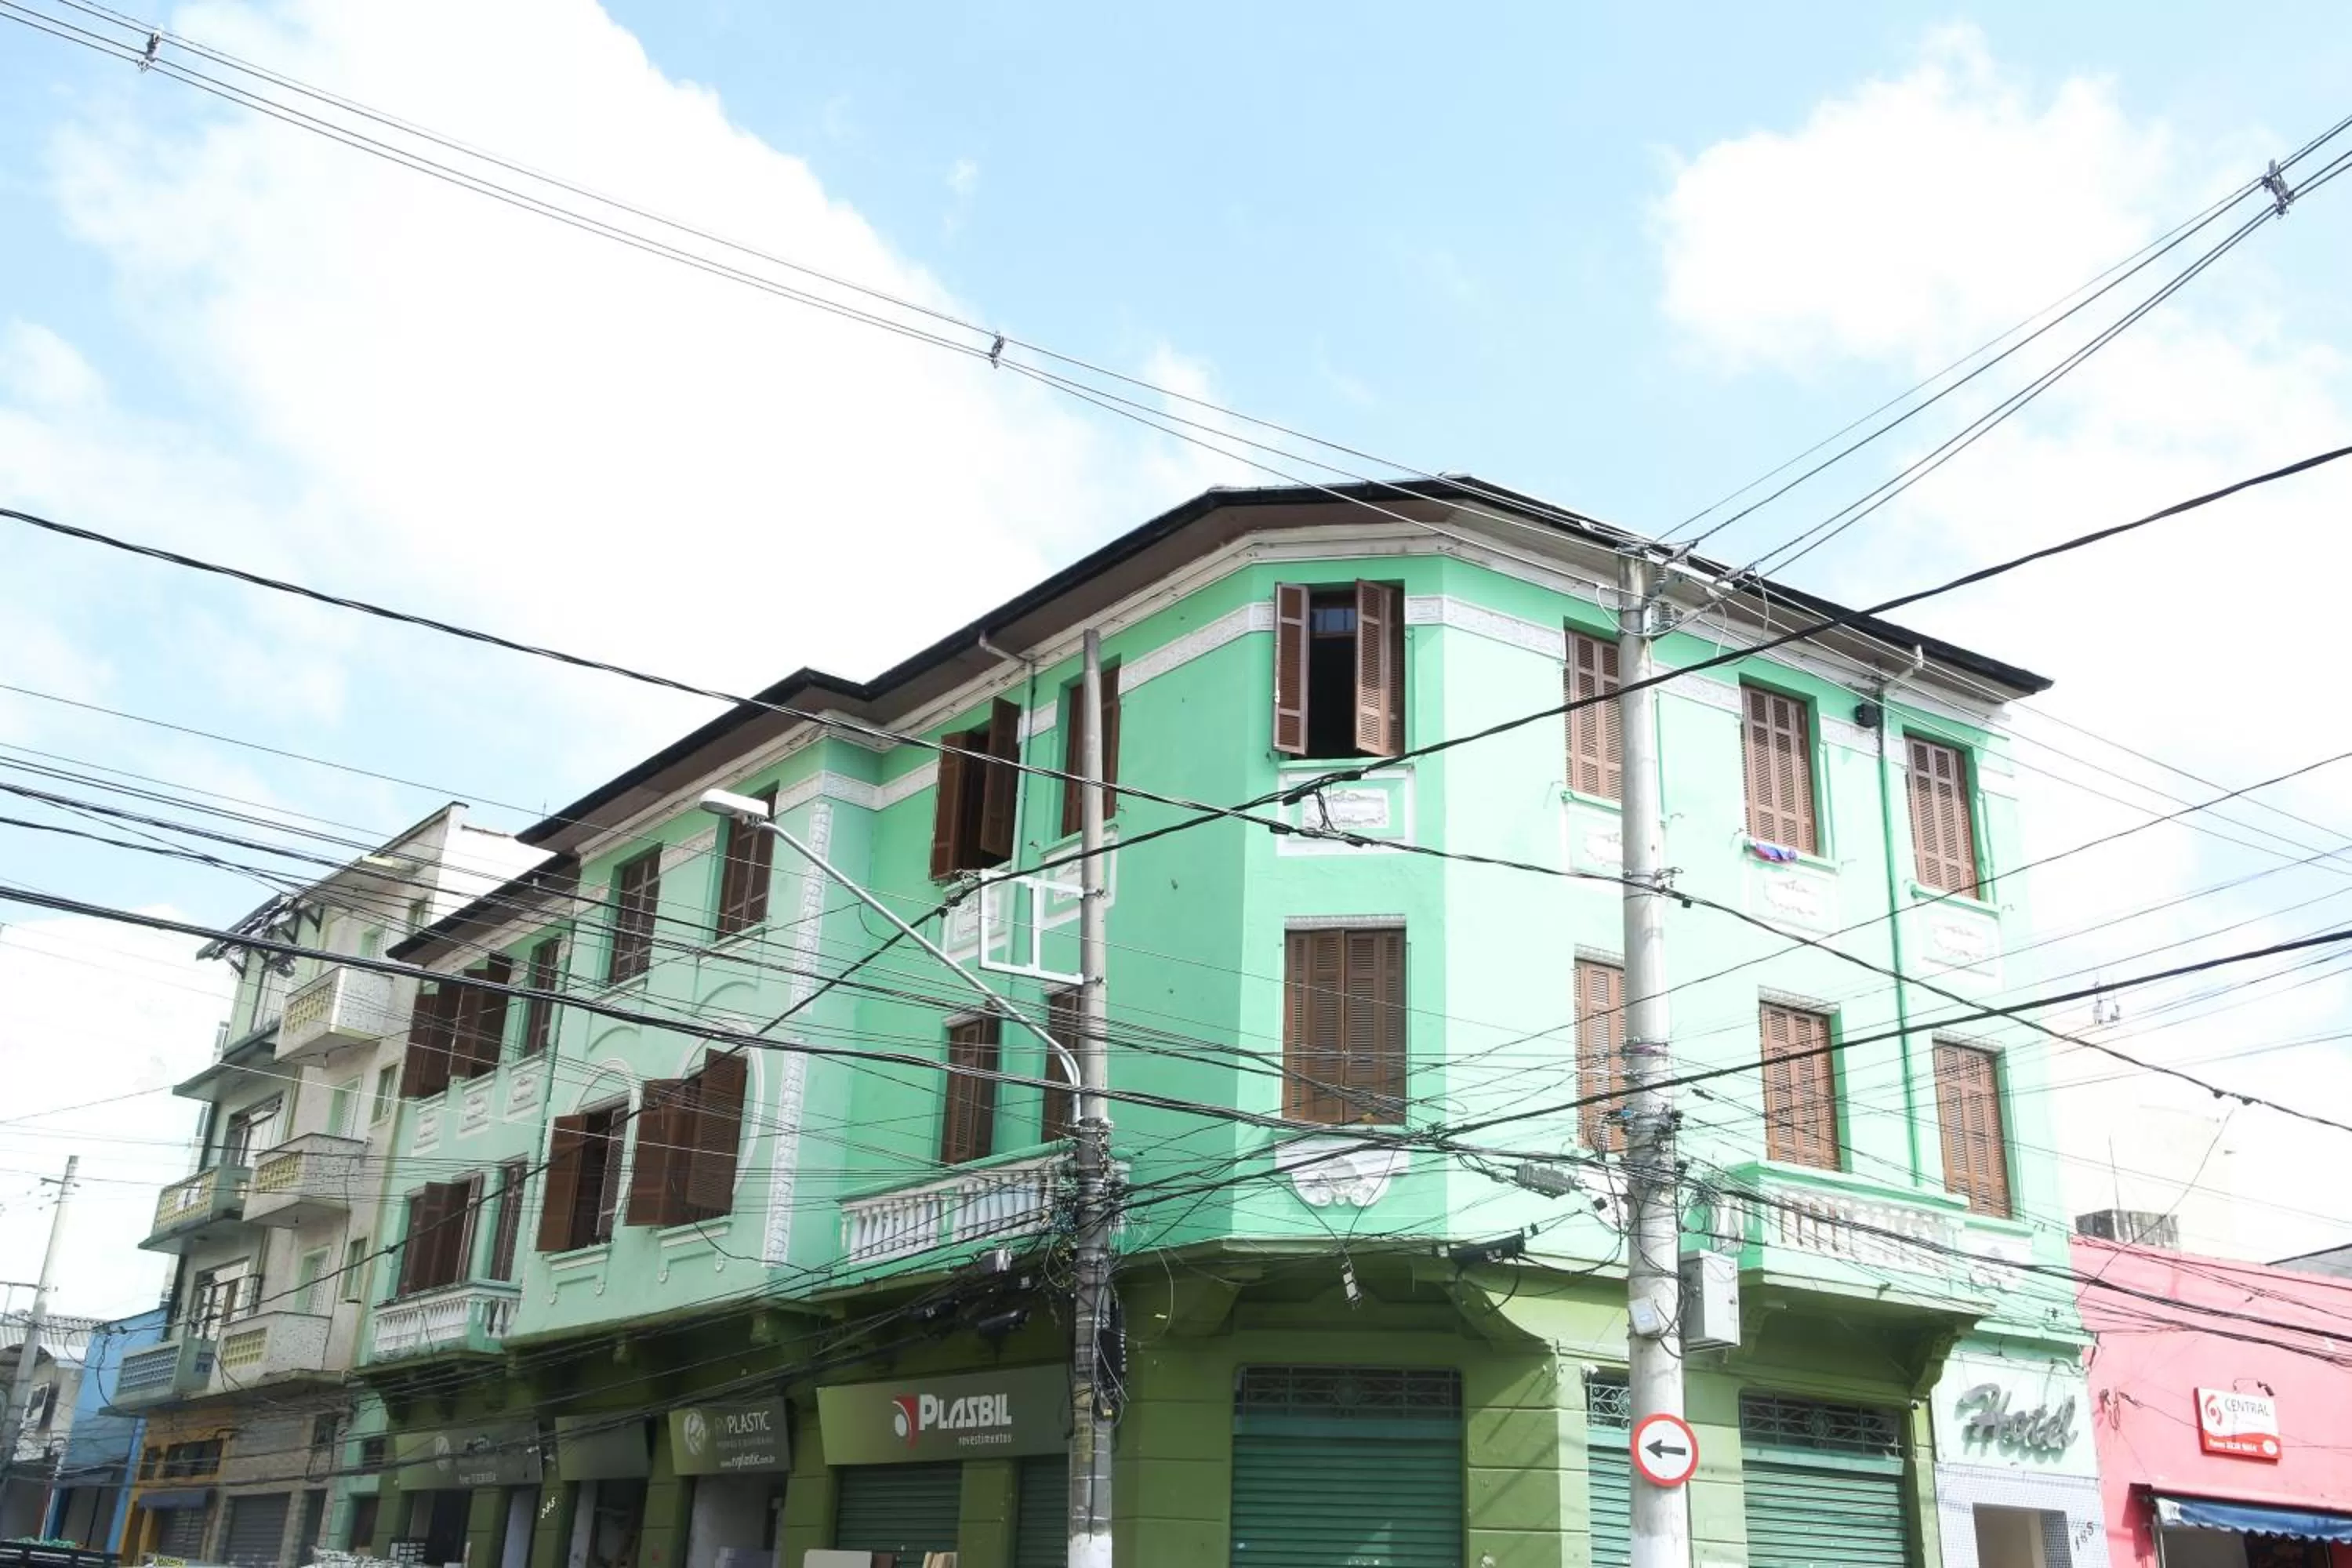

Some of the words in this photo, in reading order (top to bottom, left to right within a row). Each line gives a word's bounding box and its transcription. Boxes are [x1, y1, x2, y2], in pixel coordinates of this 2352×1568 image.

[918, 1393, 1012, 1431] PLASBIL
[1957, 1382, 2079, 1448] Hotel
[2225, 1398, 2270, 1417] CENTRAL
